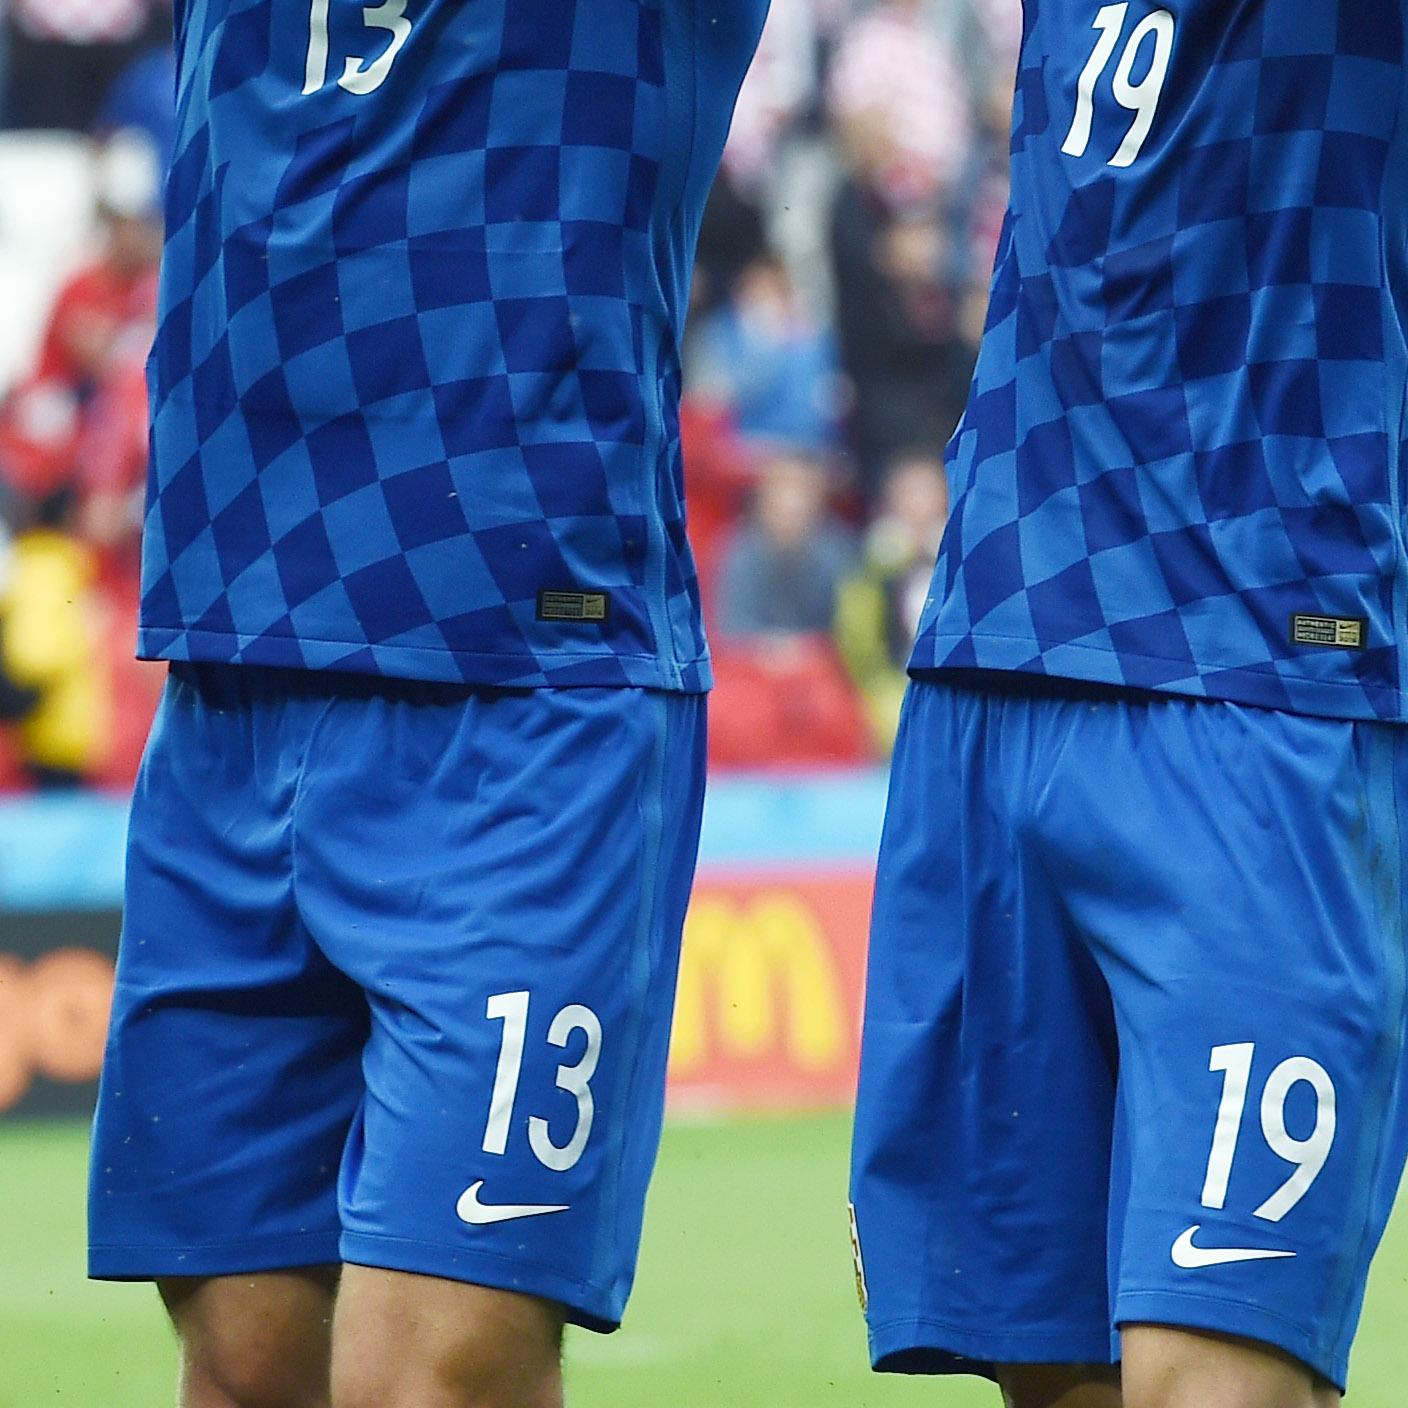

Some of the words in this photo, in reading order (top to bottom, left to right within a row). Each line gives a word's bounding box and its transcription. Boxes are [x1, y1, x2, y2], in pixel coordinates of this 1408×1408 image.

[1059, 1, 1176, 169] 19
[481, 989, 603, 1173] 13
[1200, 1041, 1338, 1223] 19
